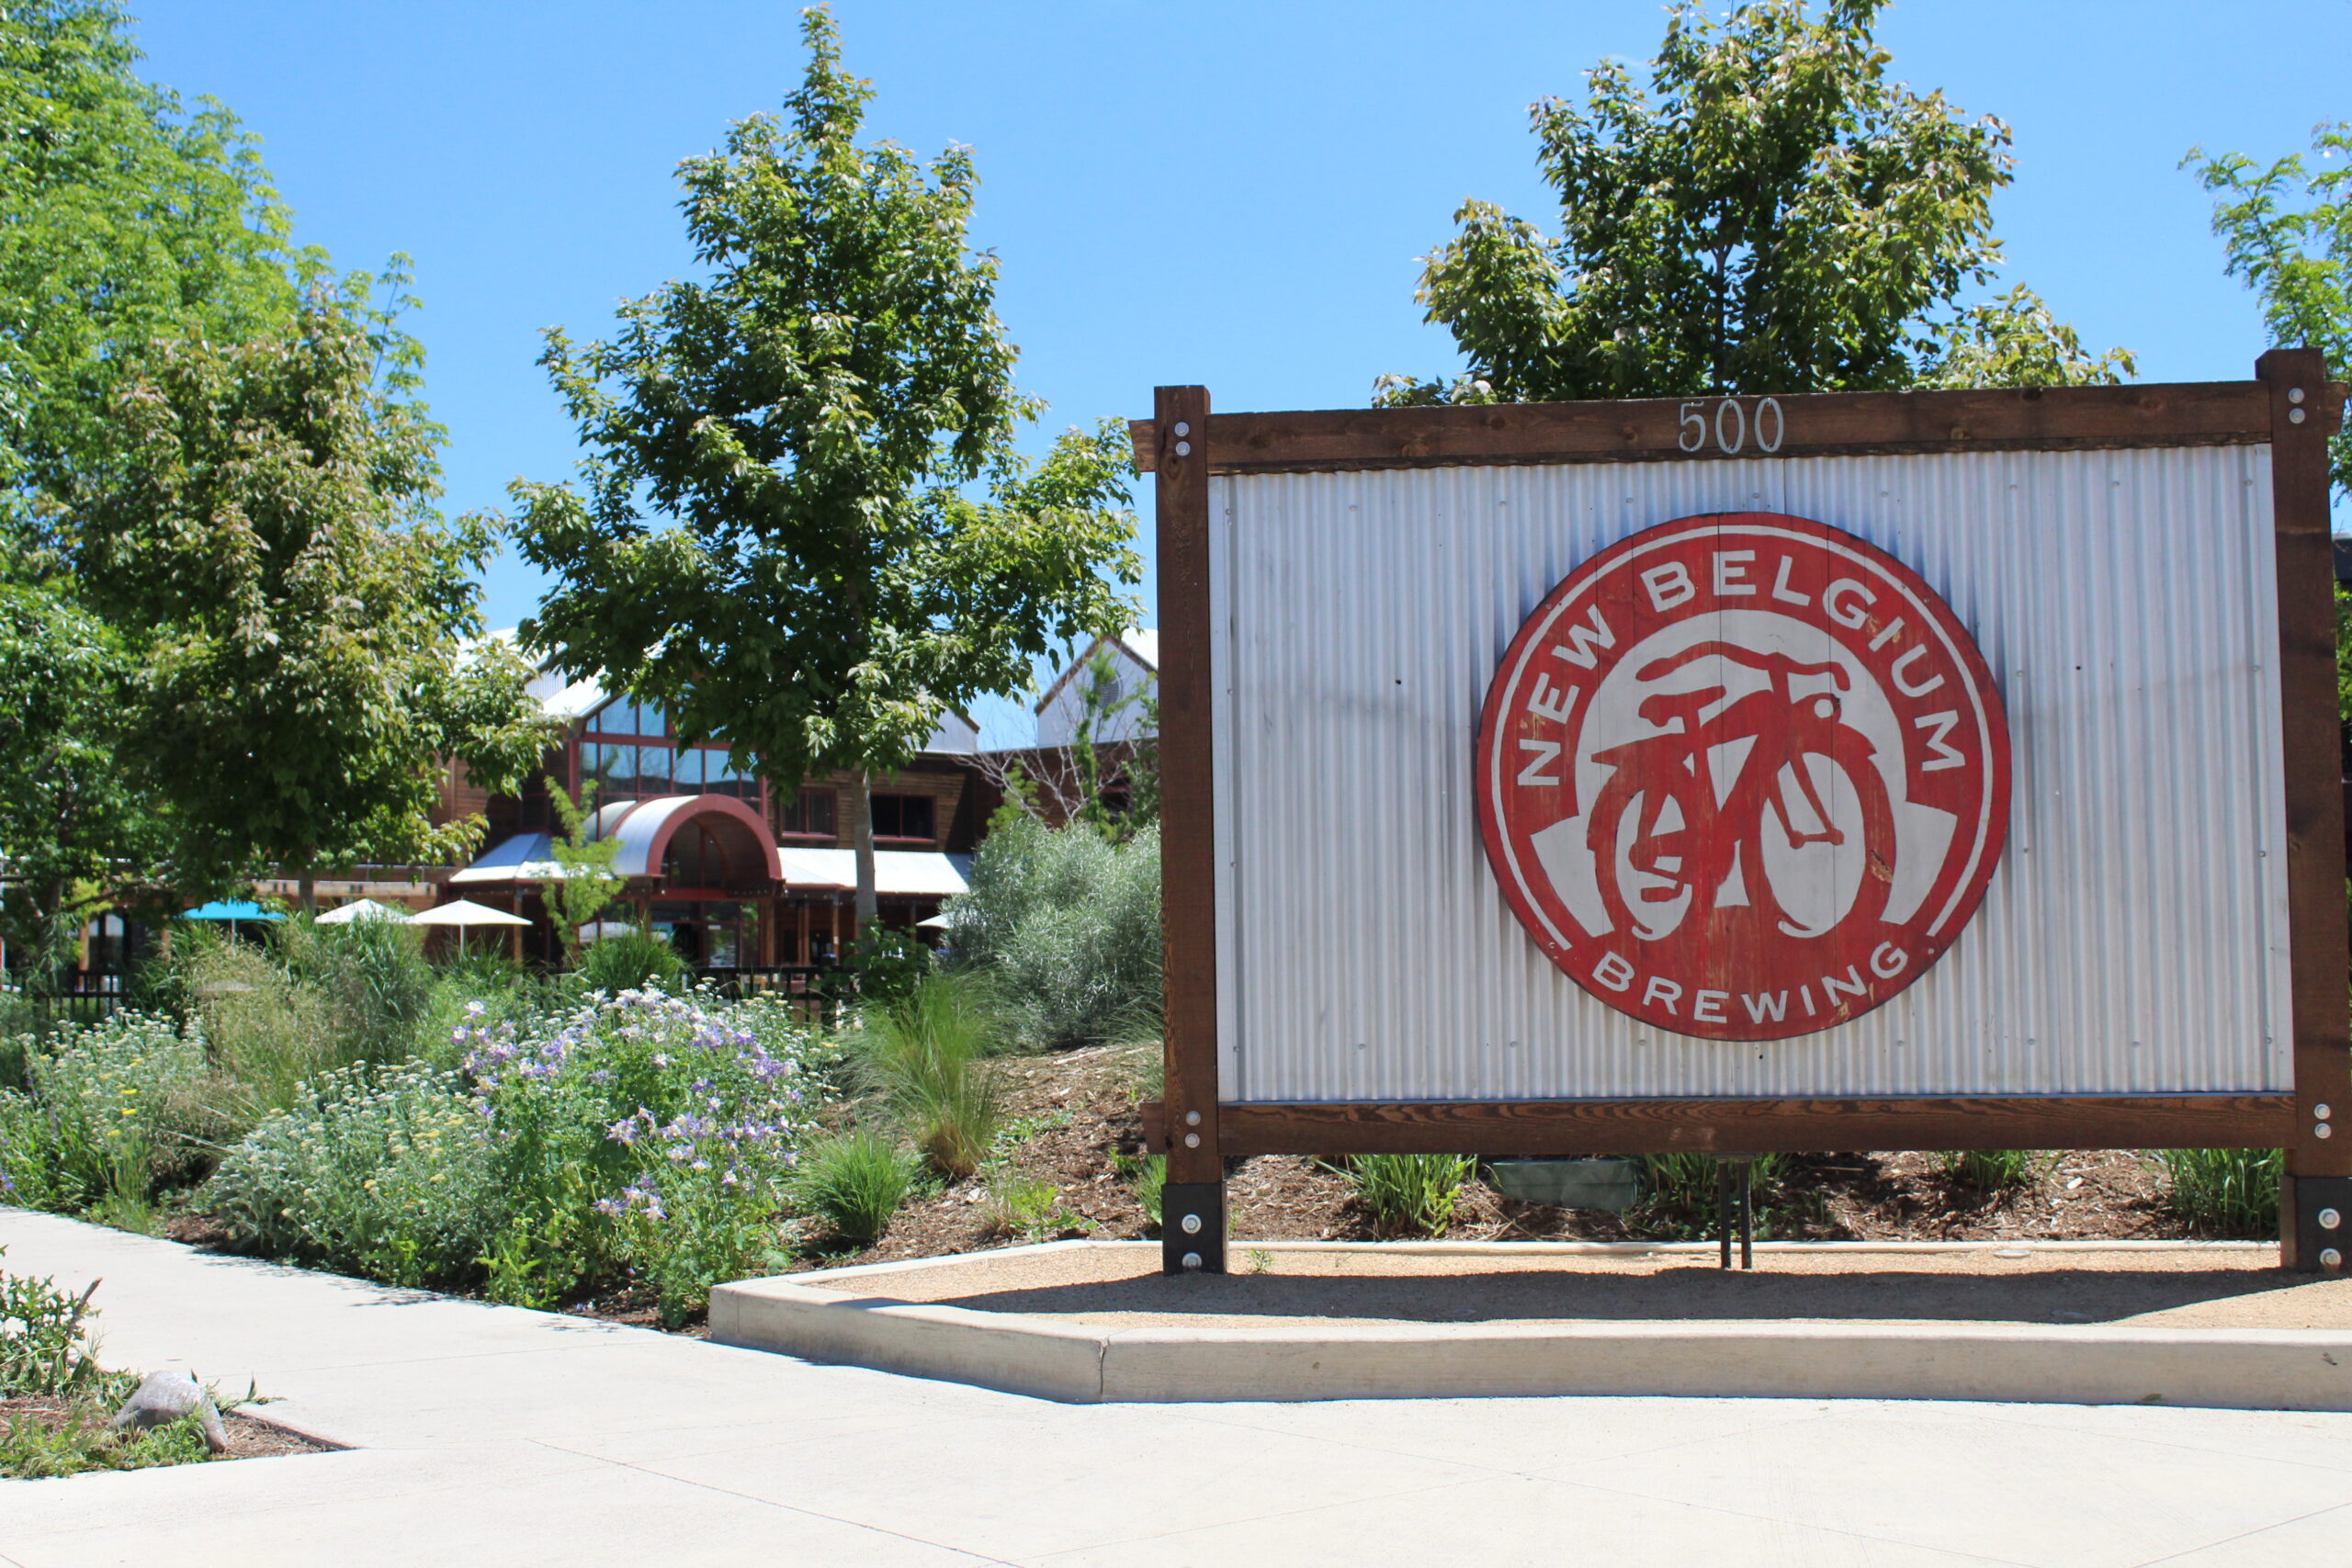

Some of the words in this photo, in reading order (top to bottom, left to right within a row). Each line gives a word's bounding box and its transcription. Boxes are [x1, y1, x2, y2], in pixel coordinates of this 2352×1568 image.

[1679, 397, 1784, 454] 500
[1517, 607, 1617, 786] NEW
[1640, 549, 1966, 772] BELGIUM
[1592, 941, 1909, 1024] BREWING
